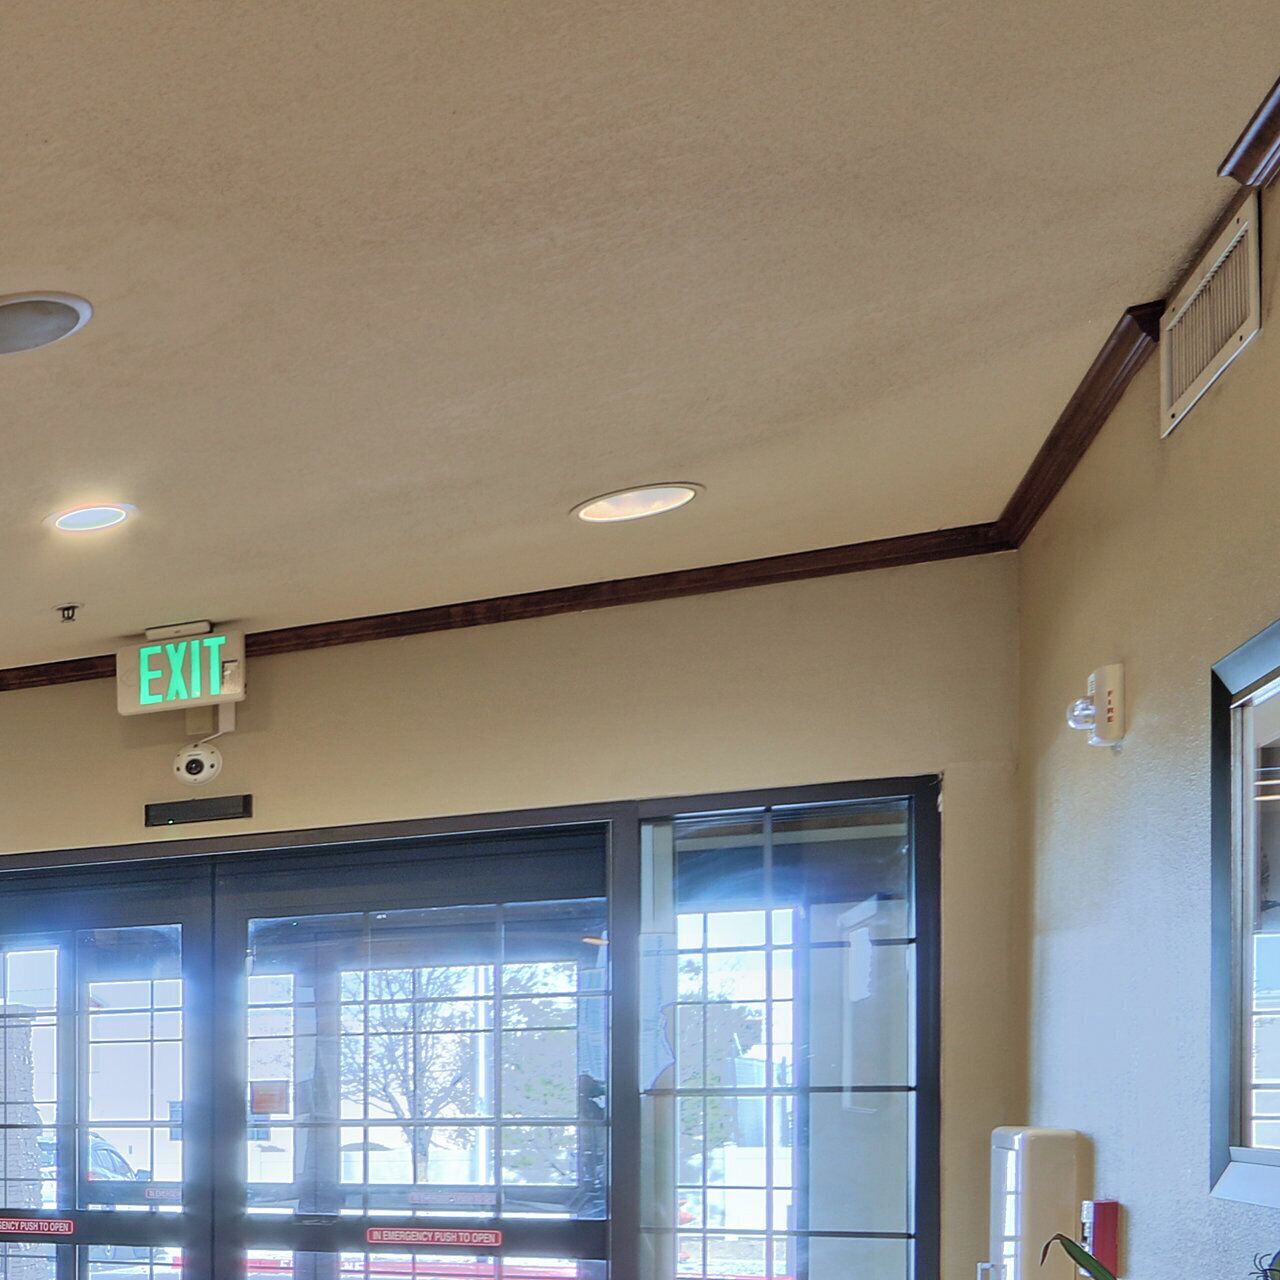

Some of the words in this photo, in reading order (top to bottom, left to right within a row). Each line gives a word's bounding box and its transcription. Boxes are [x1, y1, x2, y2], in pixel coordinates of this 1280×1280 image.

[140, 635, 226, 705] EXIT
[20, 1221, 39, 1231] PUSH
[39, 1222, 49, 1232] TO
[49, 1222, 69, 1232] OPEN
[372, 1230, 381, 1240] IN
[382, 1231, 433, 1241] EMERGENCY
[434, 1231, 457, 1242] PUSH
[458, 1232, 470, 1243] TO
[472, 1233, 496, 1243] OPEN
